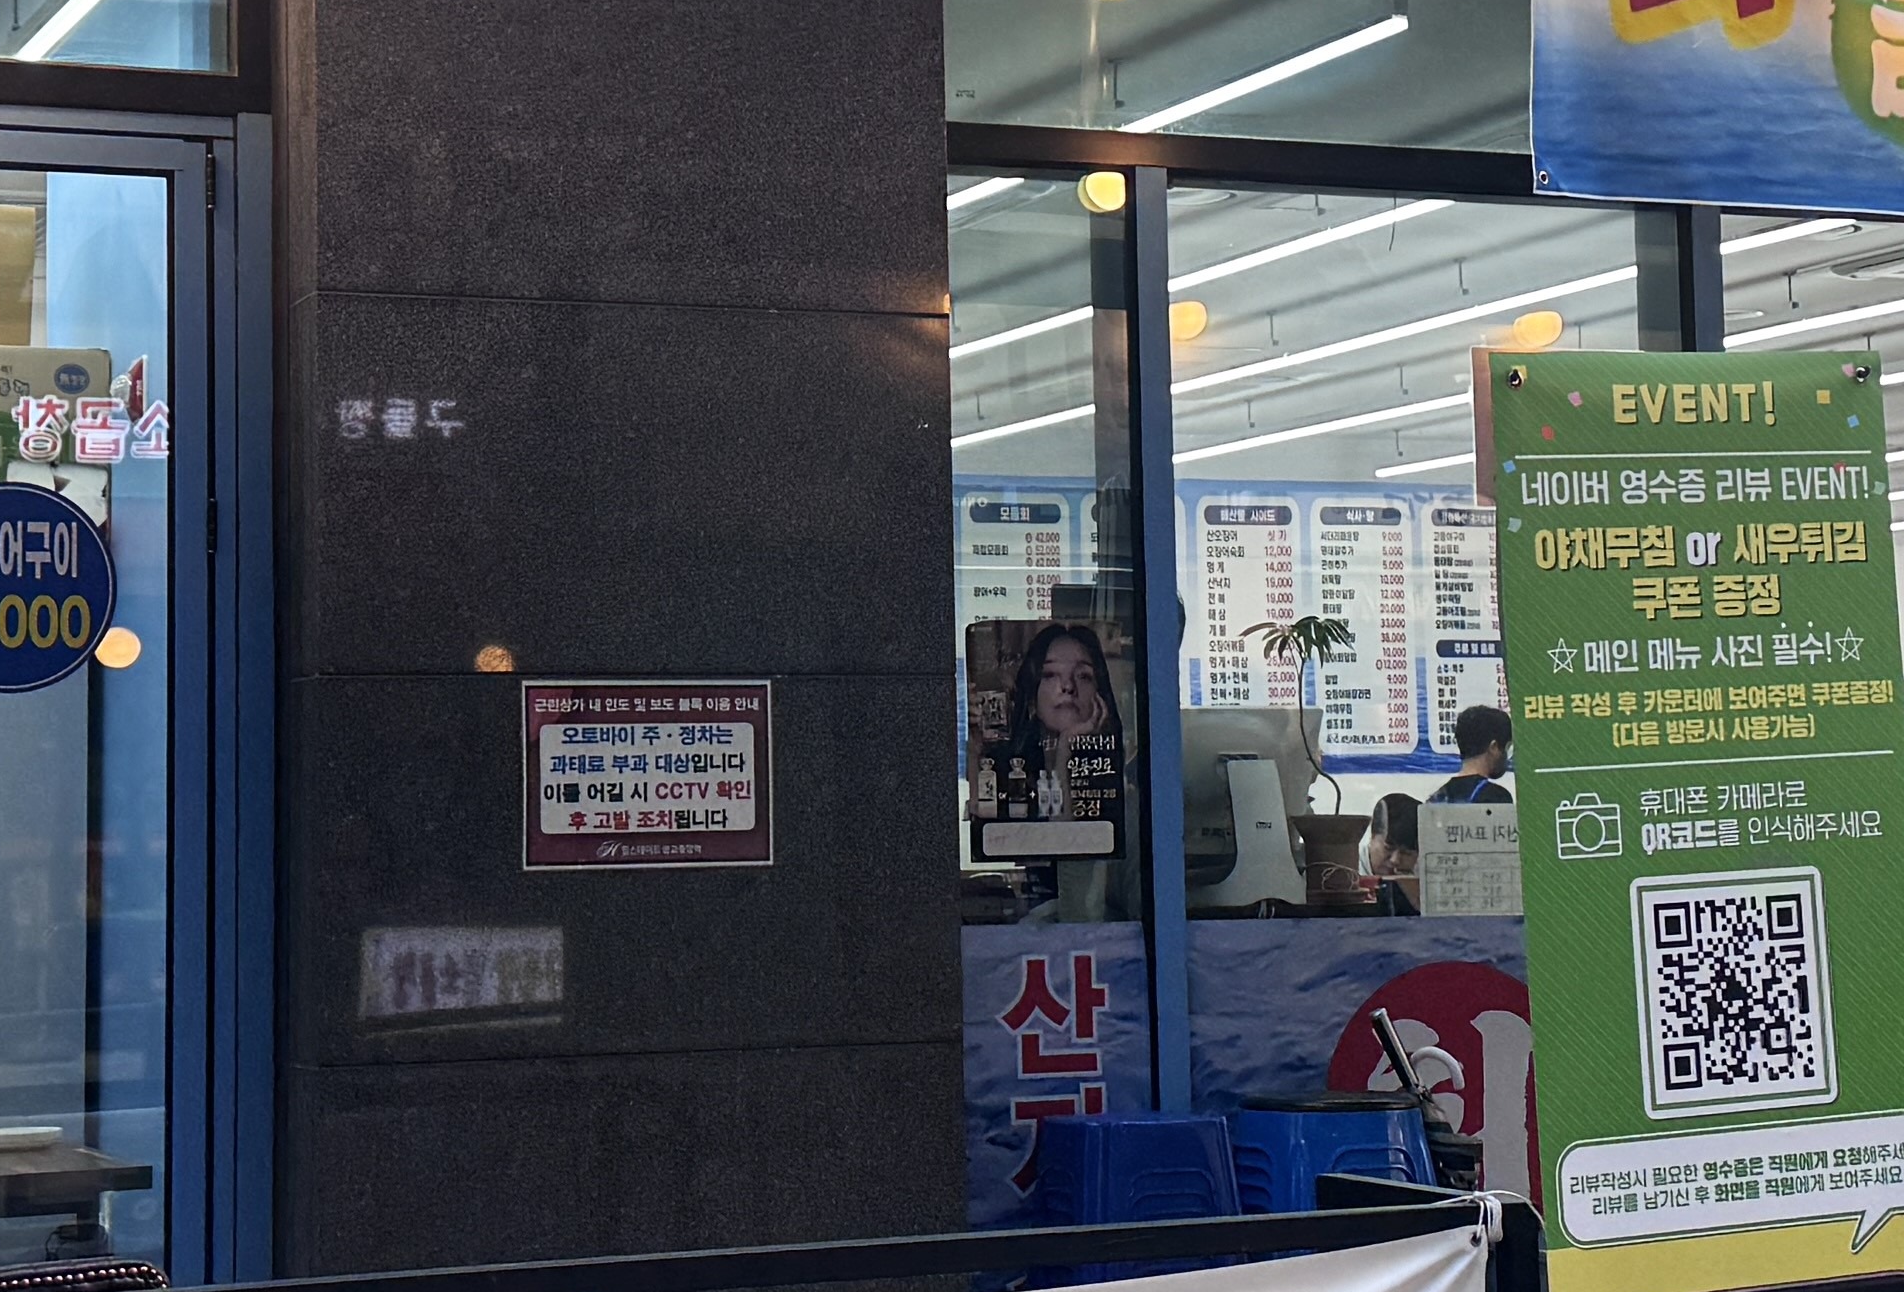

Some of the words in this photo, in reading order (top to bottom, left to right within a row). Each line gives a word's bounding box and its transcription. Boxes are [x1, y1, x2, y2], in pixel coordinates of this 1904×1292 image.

[1611, 381, 1777, 426] EVENT!
[1520, 471, 1610, 508] 네이버
[1620, 471, 1706, 505] 영수증
[1715, 469, 1772, 502] 리뷰
[1781, 466, 1870, 501] EVENT!
[1534, 523, 1676, 570] 야채무침
[1685, 531, 1721, 567] or
[1733, 521, 1868, 565] 새우튀김
[1632, 576, 1704, 620] 쿠폰
[1712, 574, 1782, 618] 증정
[1584, 640, 1639, 675] 메인
[1648, 637, 1702, 671] 메뉴
[1711, 634, 1764, 669] 사진
[1773, 629, 1833, 666] 필수!
[650, 698, 674, 711] 보도
[1524, 695, 1565, 719] 리뷰
[1571, 692, 1611, 719] 작성
[1617, 691, 1637, 716] 후
[1644, 686, 1722, 714] 카운터에
[1728, 683, 1806, 710] 보여주면
[1811, 680, 1894, 707] 쿠폰증정!
[561, 726, 635, 745] 오토바이
[642, 727, 660, 745] 주
[679, 726, 733, 745] 정차는
[1612, 721, 1660, 749] (다음
[1666, 716, 1725, 745] 방문시
[1731, 712, 1816, 742] 사용가능)
[550, 754, 605, 775] 과태료
[611, 754, 648, 774] 부과
[655, 753, 745, 773] 대상입니다
[544, 783, 580, 803] 이를
[587, 783, 623, 803] 어길
[631, 781, 648, 802] 시
[655, 781, 709, 800] CCTV
[716, 780, 751, 800] 확인
[1639, 786, 1709, 817] 휴대폰
[1717, 780, 1807, 811] 카메라로
[568, 811, 587, 830] 후
[593, 811, 630, 830] 고발
[637, 809, 728, 830] 조치됩니다
[1641, 817, 1741, 856] QR코드를
[1747, 809, 1883, 846] 인식해주세요
[1569, 1169, 1648, 1196] 리뷰작성시
[1652, 1164, 1699, 1189] 필요한
[1703, 1158, 1764, 1181] 영수증은
[1768, 1152, 1829, 1175] 직원에게
[1592, 1192, 1639, 1216] 리뷰를
[1644, 1188, 1690, 1211] 남기신
[1694, 1186, 1711, 1207] 후
[1715, 1180, 1761, 1203] 화면을
[1765, 1174, 1825, 1199] 직원에게
[1828, 1165, 1903, 1192] 보여주세요
